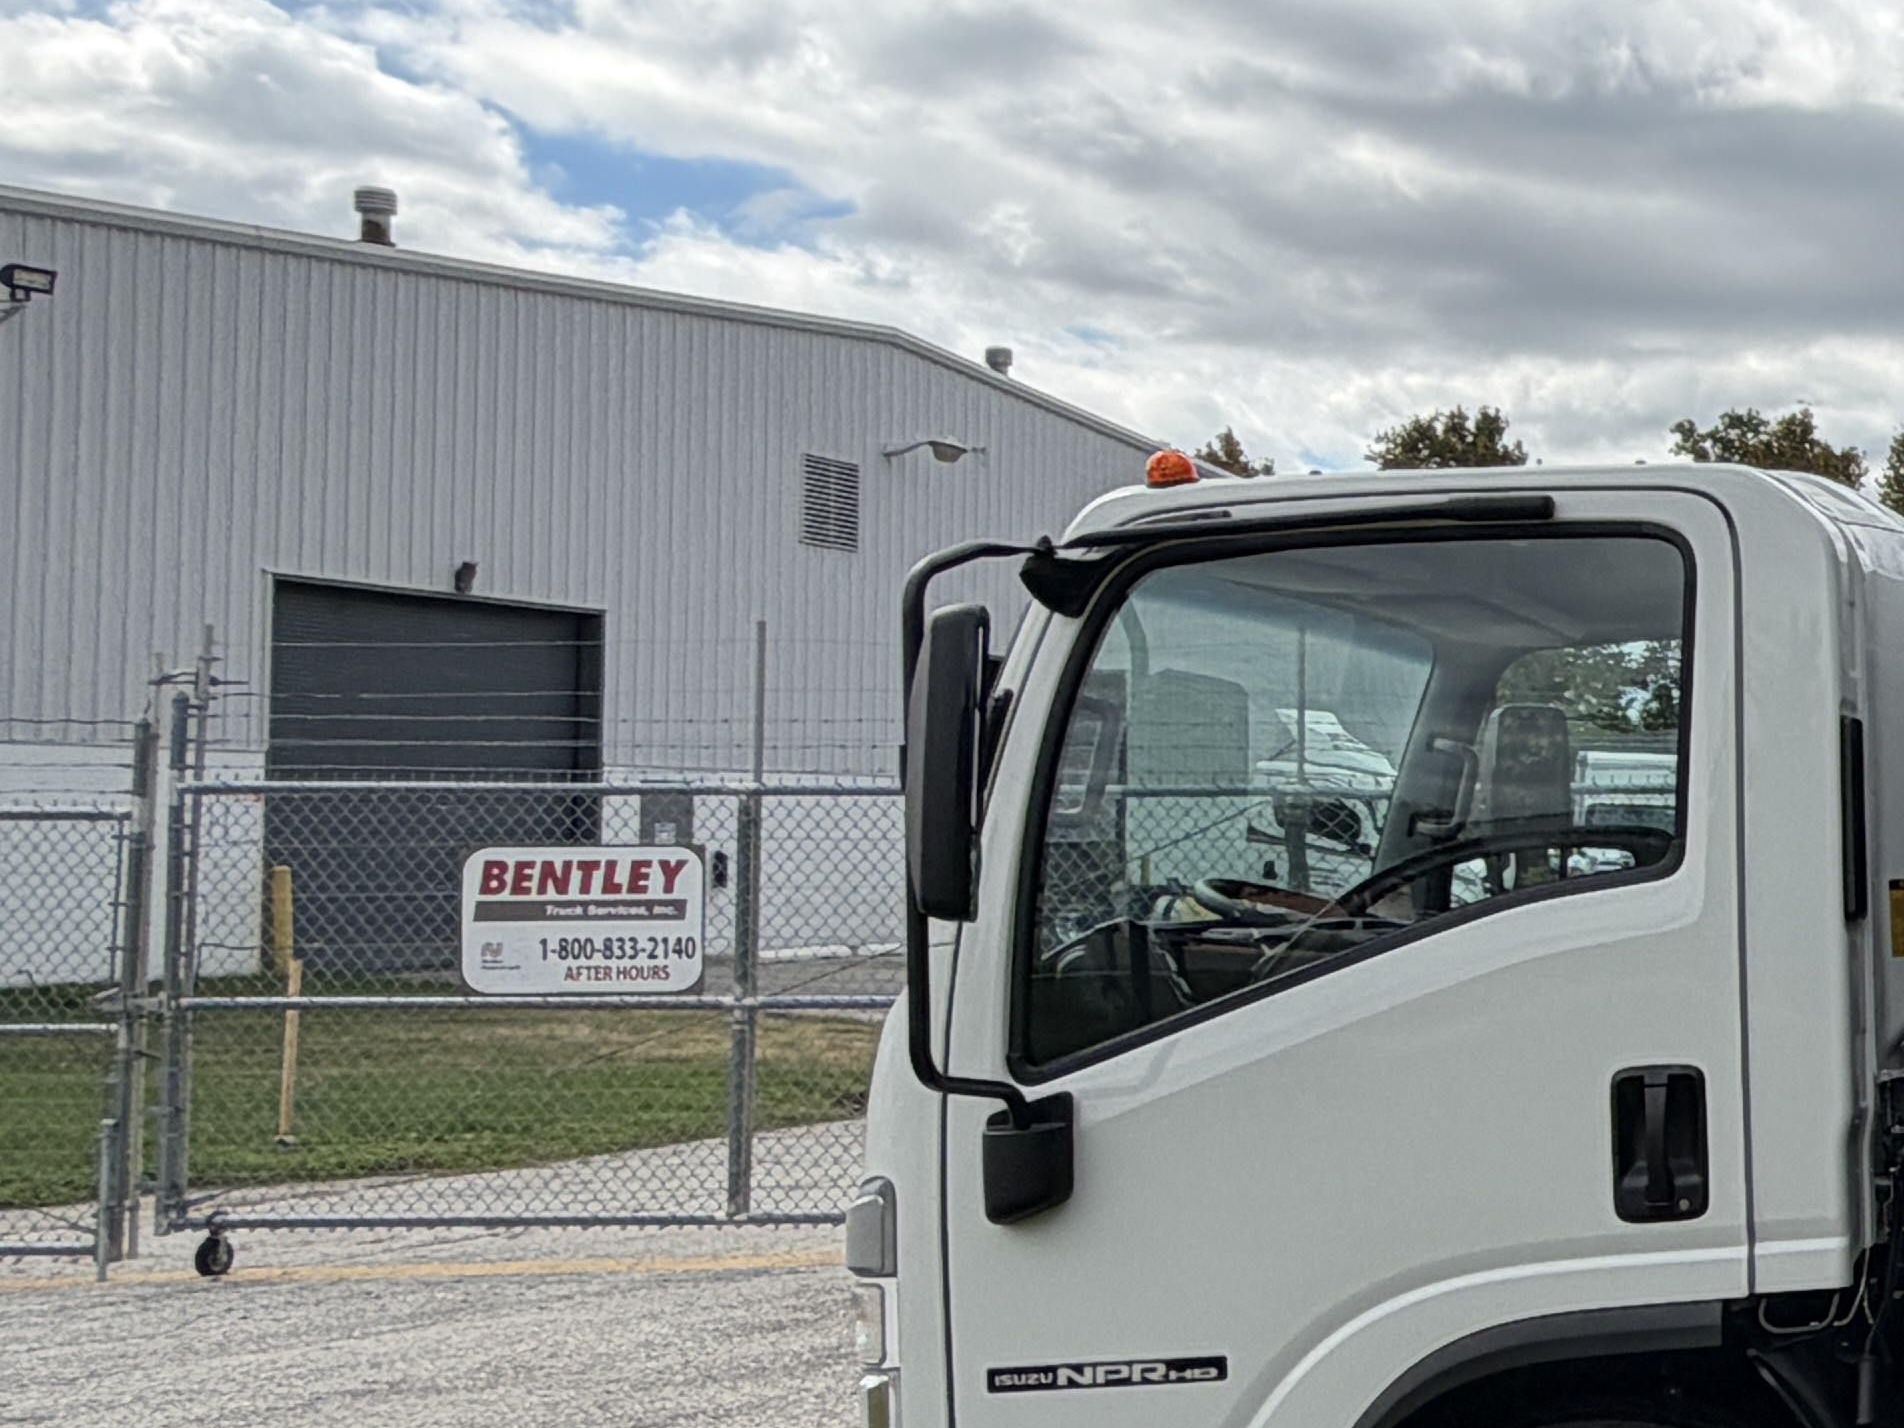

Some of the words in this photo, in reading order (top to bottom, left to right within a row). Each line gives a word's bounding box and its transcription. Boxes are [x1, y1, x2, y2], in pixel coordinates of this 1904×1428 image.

[479, 859, 689, 896] BENTLEY
[545, 904, 584, 916] Truck
[587, 904, 649, 916] Services,
[652, 904, 679, 916] Inc.
[538, 936, 697, 961] 1-800-833-2140
[564, 966, 613, 982] AFTER
[616, 964, 671, 981] HOURS
[994, 1372, 1053, 1387] ISUZU
[1056, 1362, 1167, 1386] NPR
